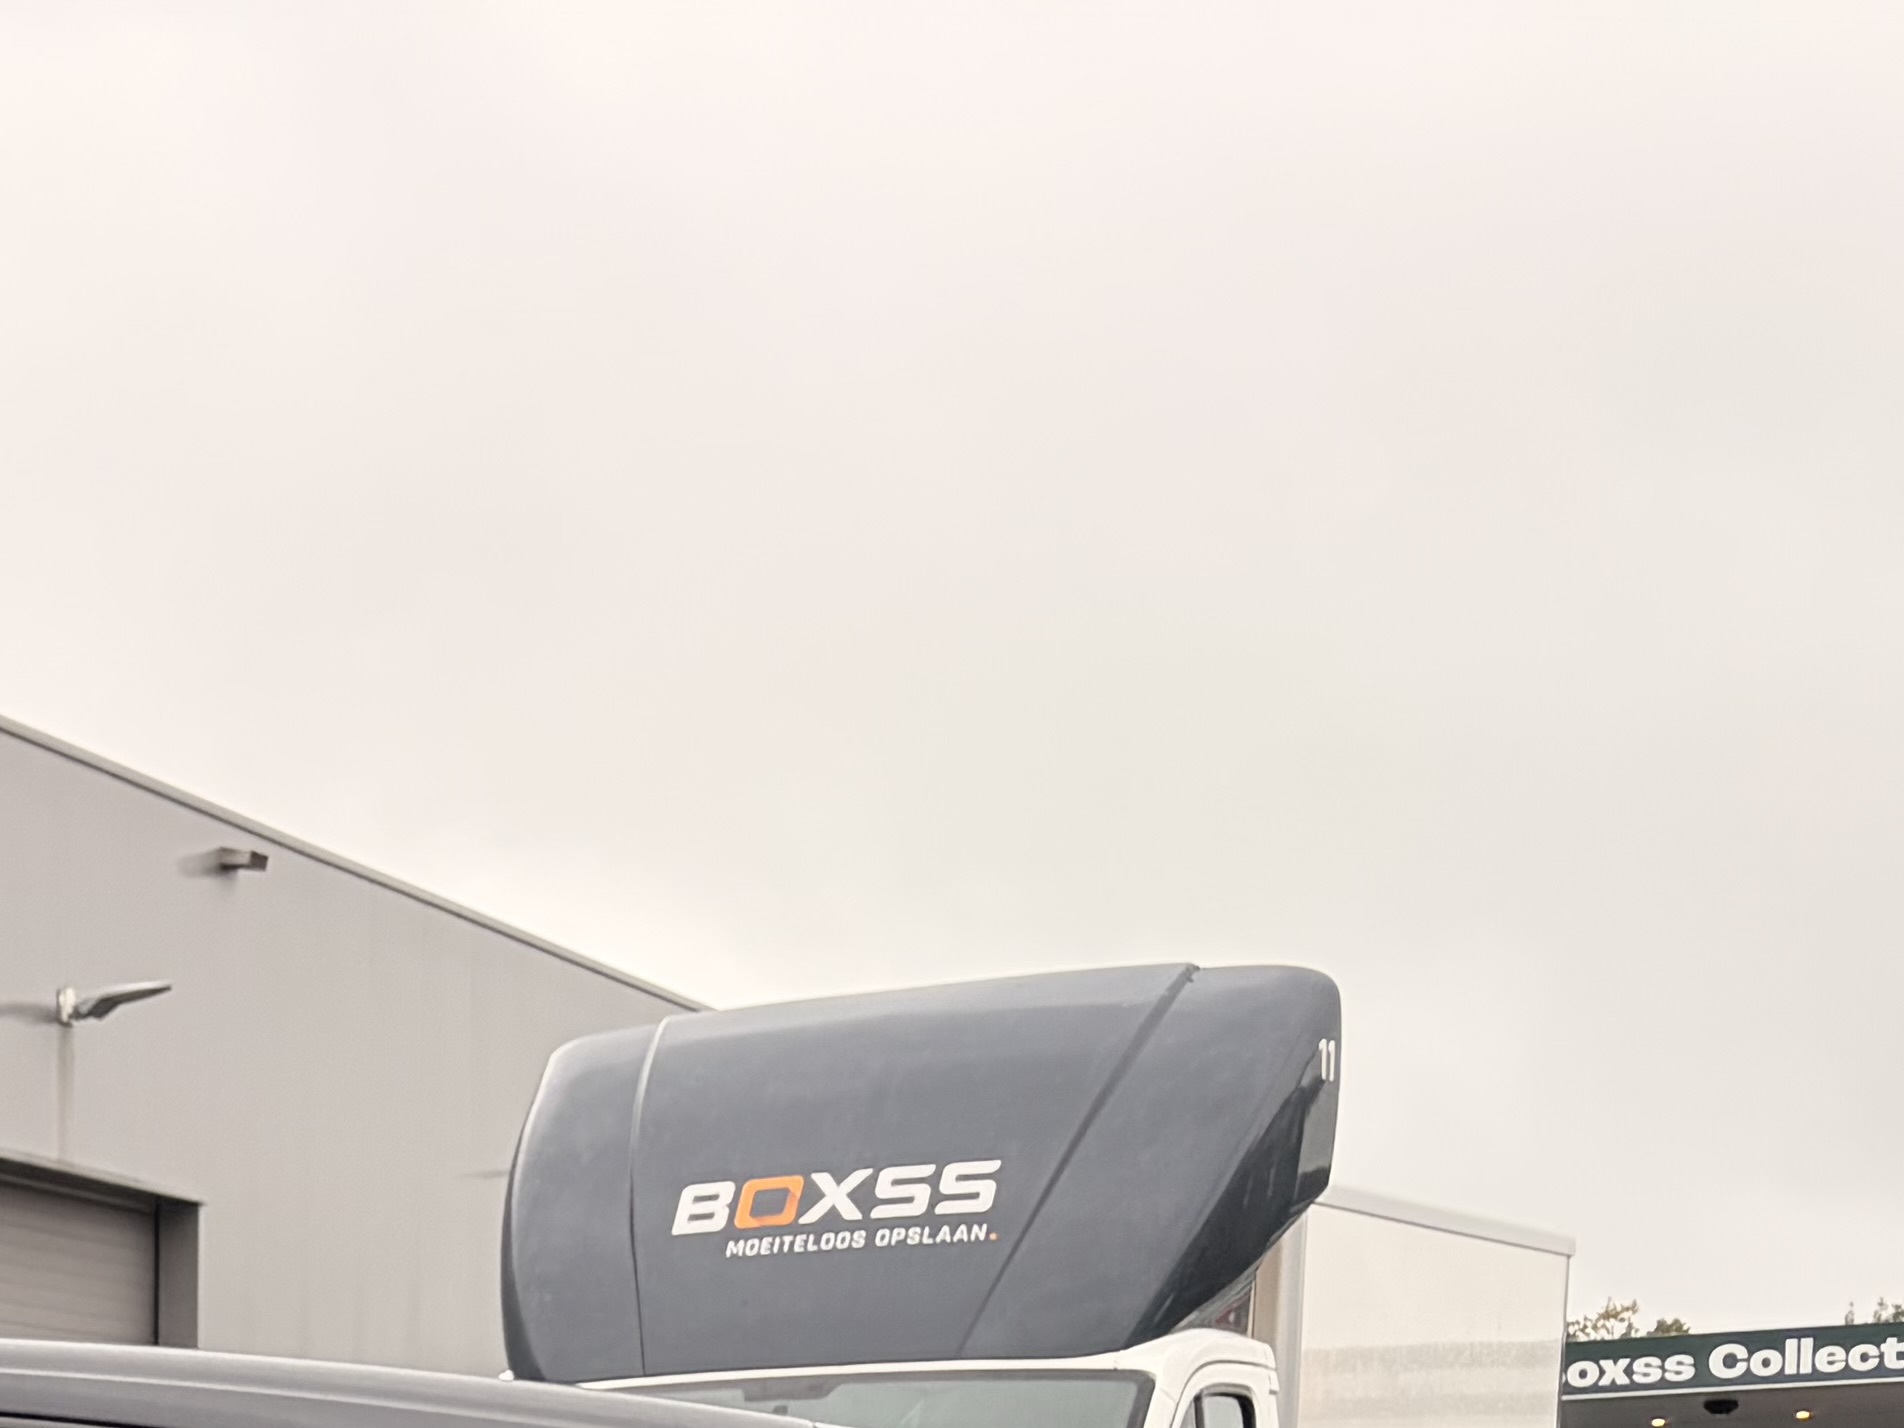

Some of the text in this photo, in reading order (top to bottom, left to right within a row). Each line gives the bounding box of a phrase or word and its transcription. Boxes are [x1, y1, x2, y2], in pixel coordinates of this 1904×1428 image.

[1318, 1038, 1336, 1082] 11
[671, 1159, 1002, 1236] BOXSS
[725, 1223, 999, 1259] MOEITELOOS OPSLAAN.
[1561, 1336, 1904, 1388] oxss Collect
